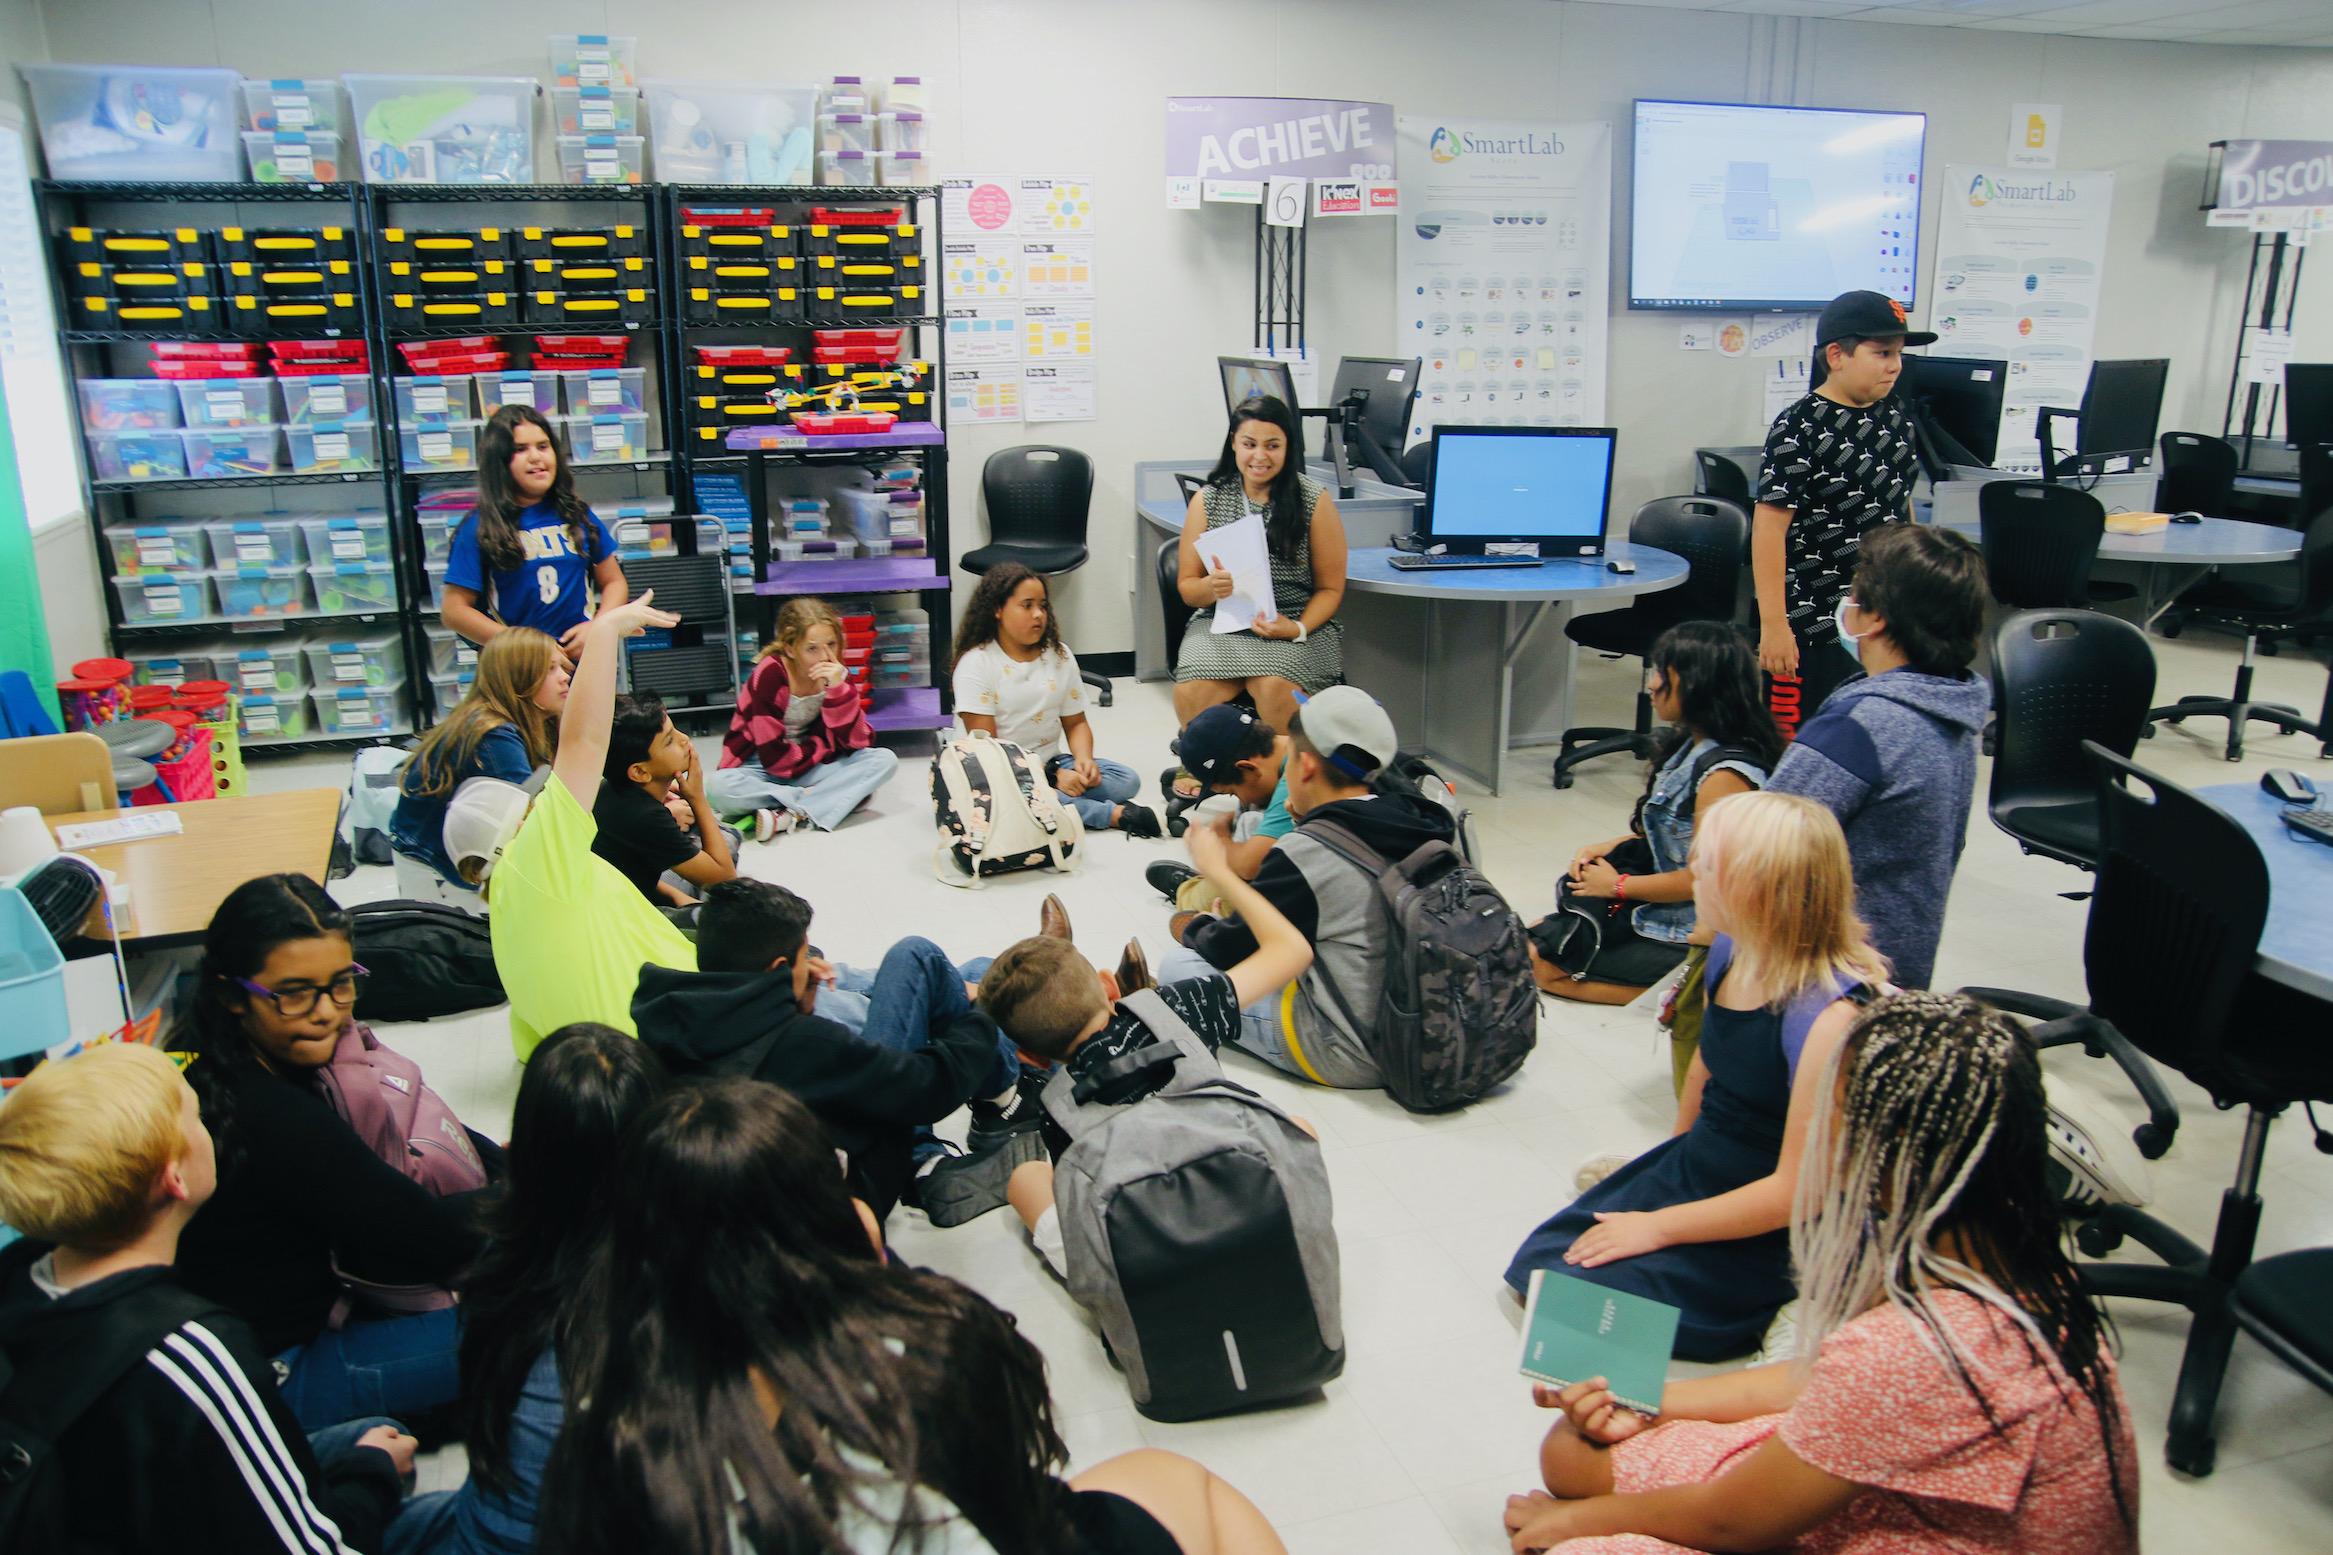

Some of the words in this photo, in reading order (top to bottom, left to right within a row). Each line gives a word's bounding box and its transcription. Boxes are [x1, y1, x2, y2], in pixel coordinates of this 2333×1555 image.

[1197, 107, 1373, 177] ACHIEVE
[1463, 131, 1565, 155] SmartLab
[1276, 183, 1298, 222] 6
[1995, 179, 2076, 201] SmartLab
[1752, 318, 1802, 350] OBSERVE
[537, 565, 560, 604] 8
